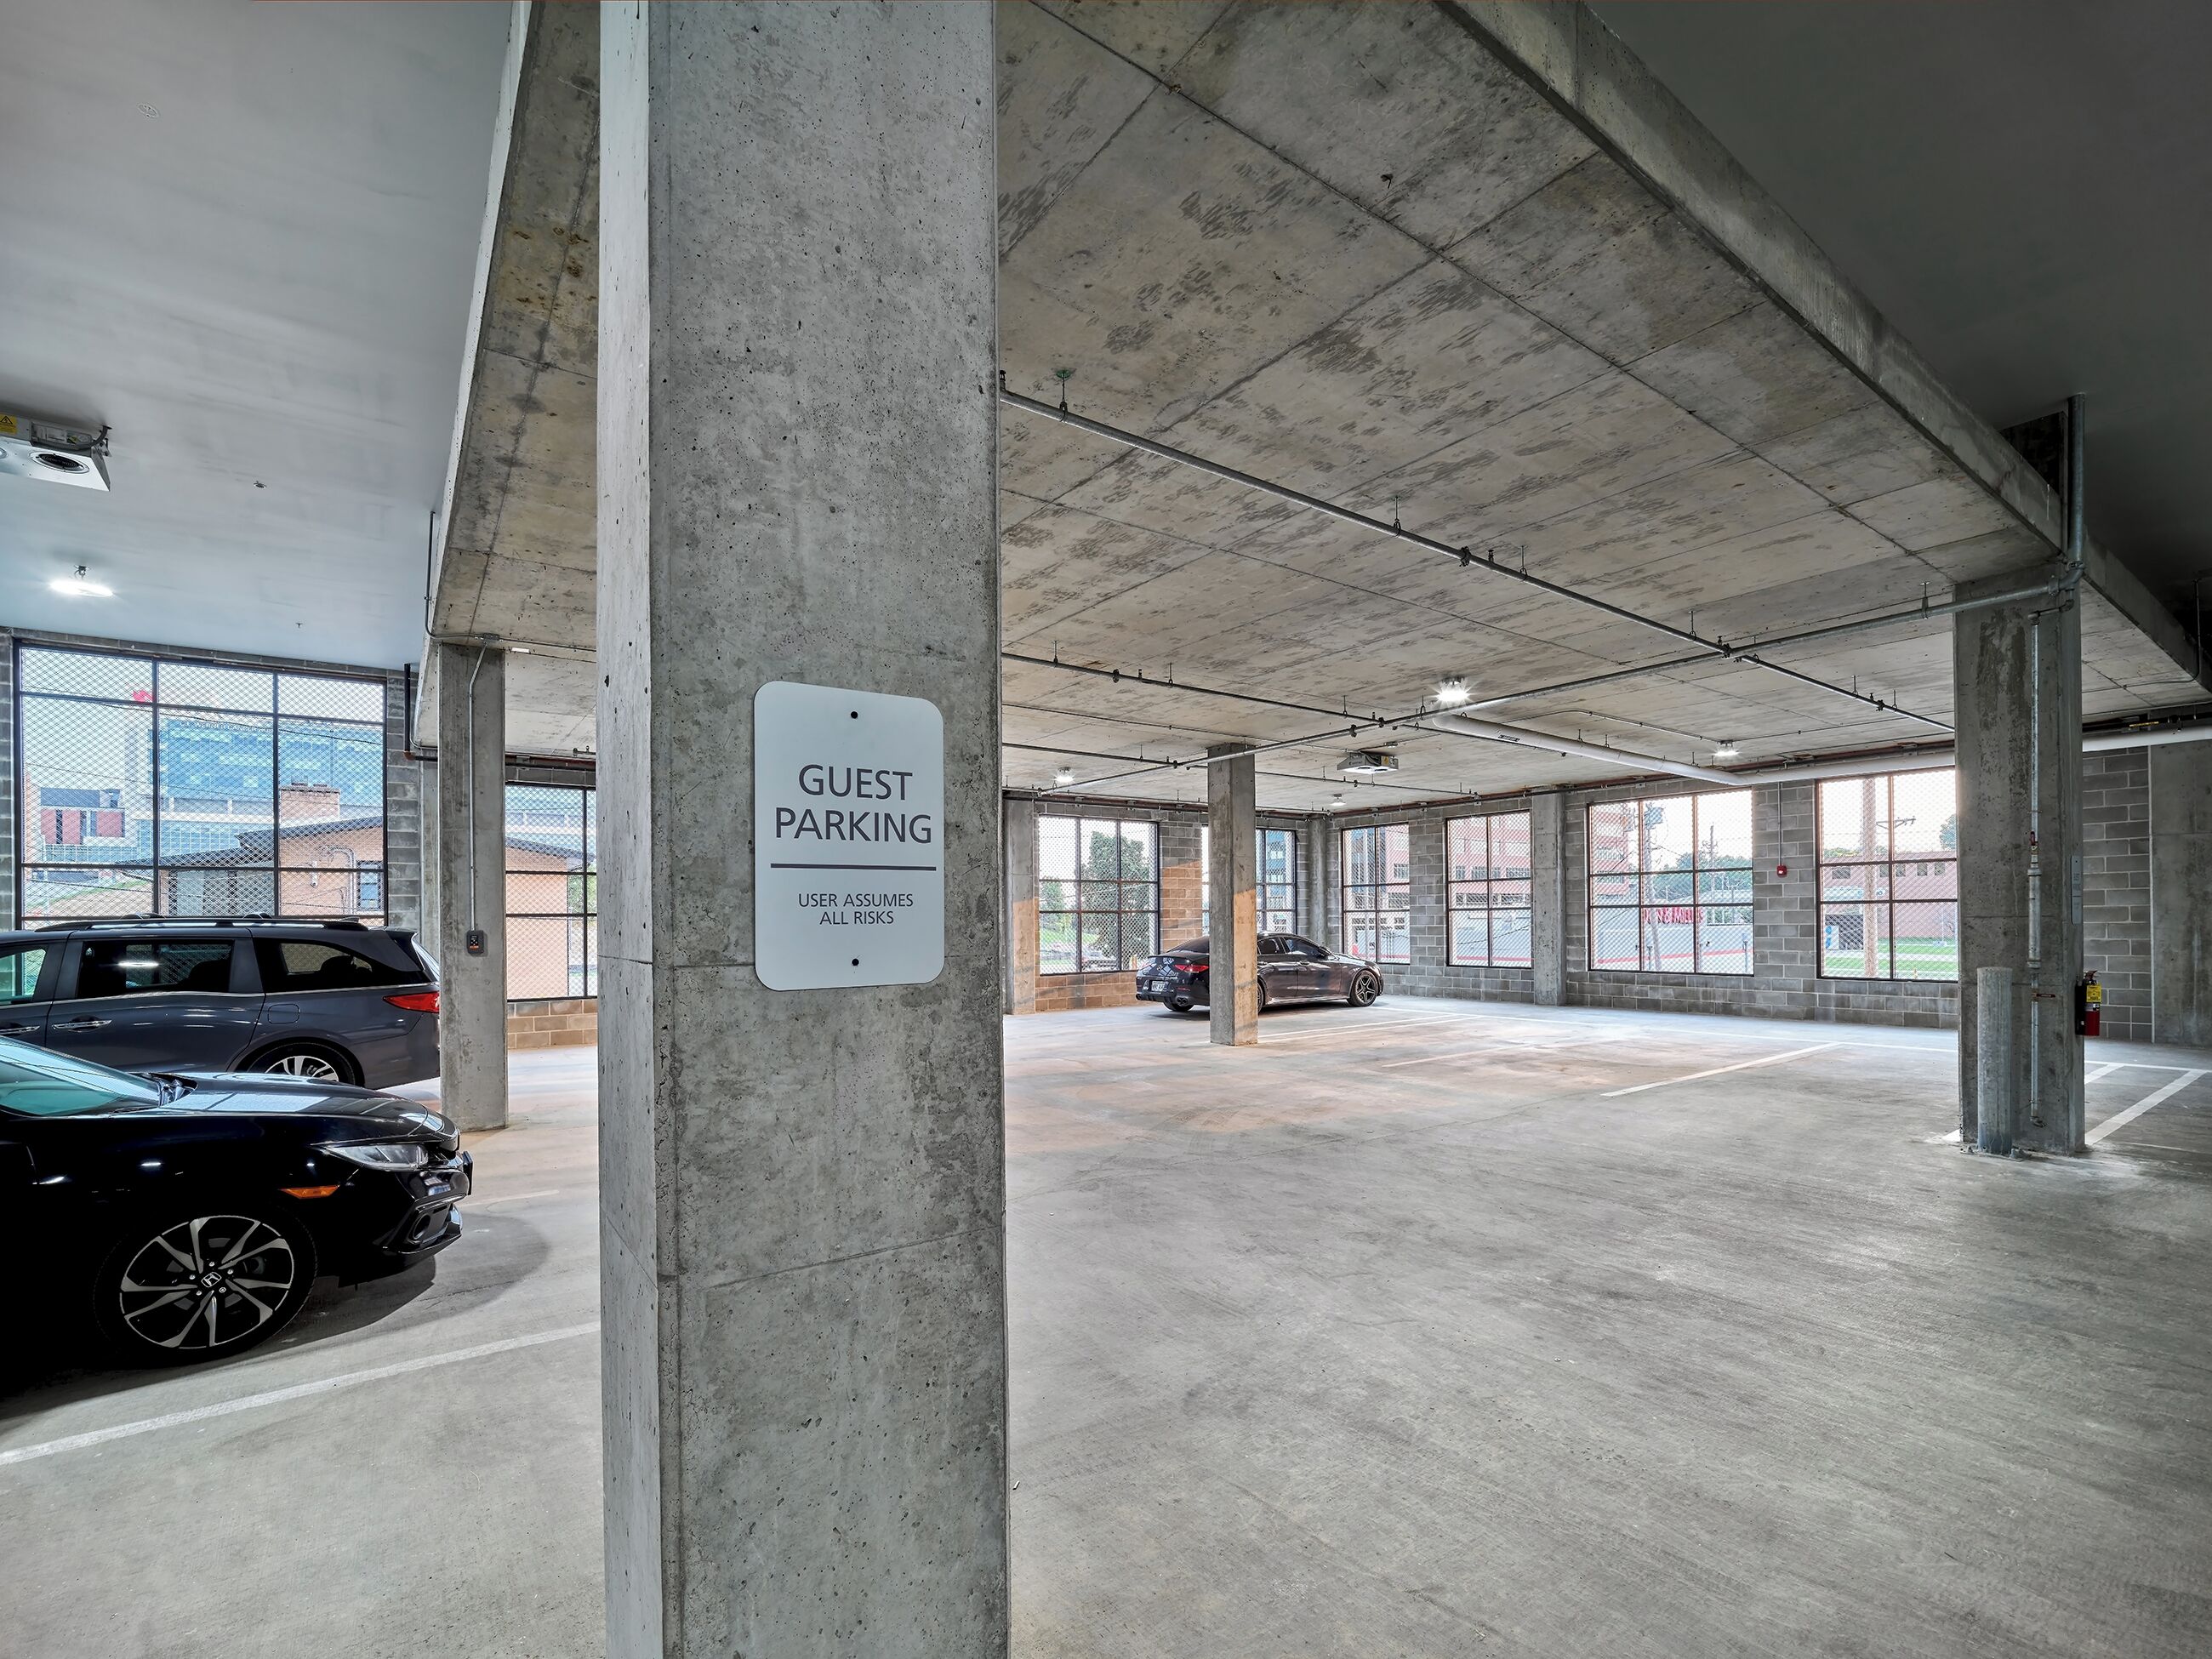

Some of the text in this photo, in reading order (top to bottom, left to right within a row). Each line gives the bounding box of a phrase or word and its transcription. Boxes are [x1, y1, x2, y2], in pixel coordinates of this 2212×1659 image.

[798, 764, 913, 801] GUEST
[775, 807, 932, 844] PARKING
[798, 892, 914, 908] USER ASSUMES
[819, 910, 894, 926] ALL RISKS
